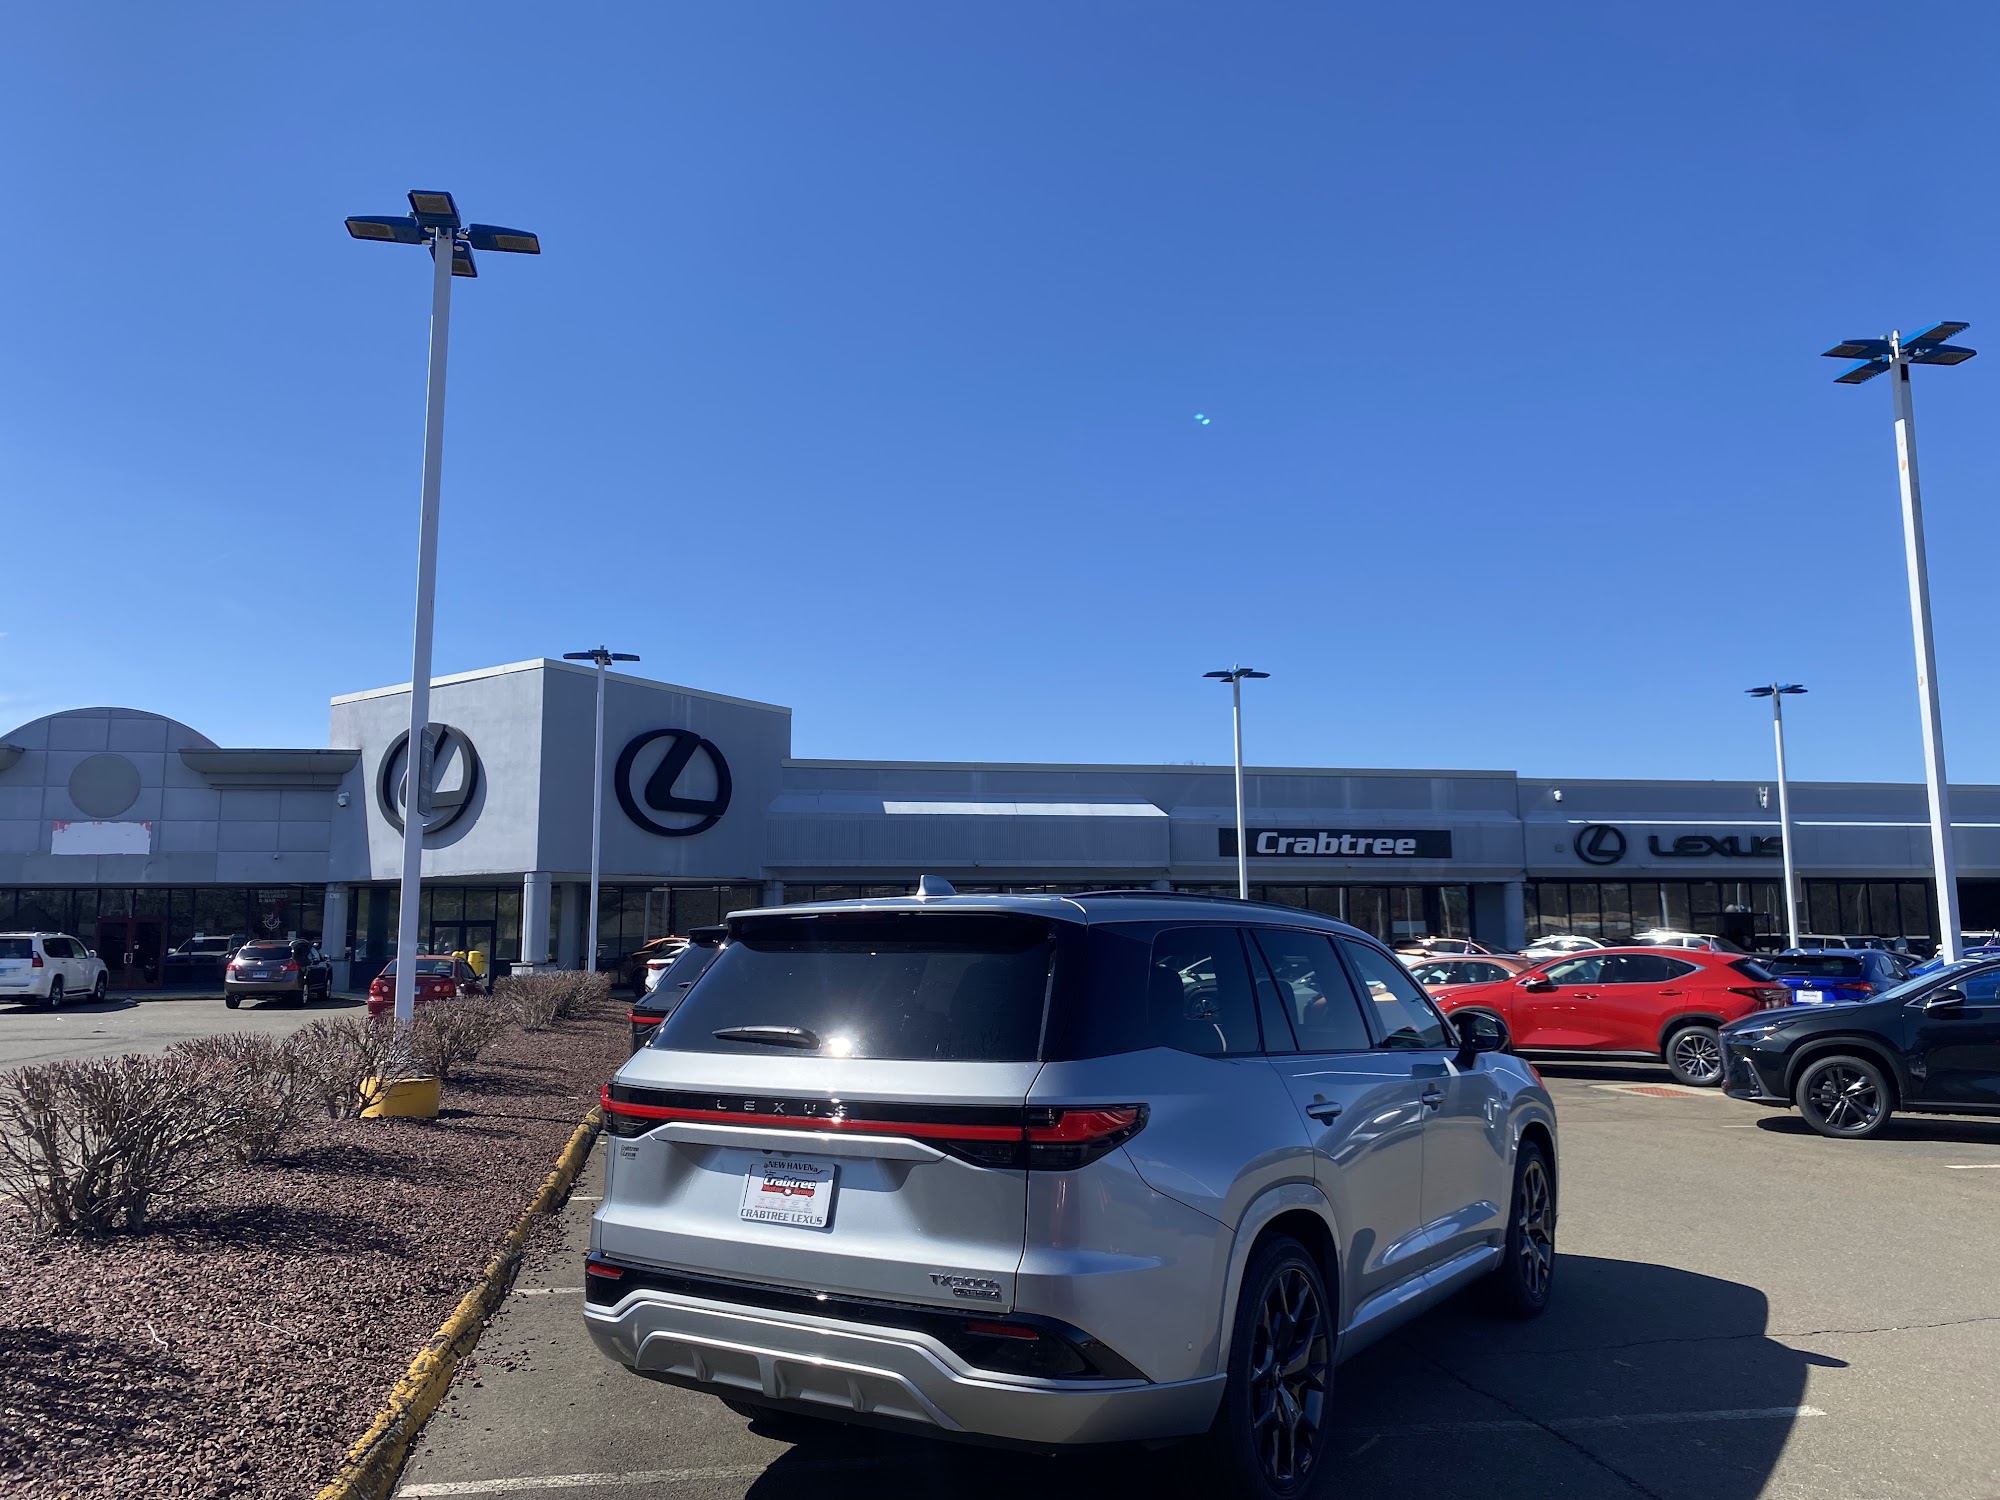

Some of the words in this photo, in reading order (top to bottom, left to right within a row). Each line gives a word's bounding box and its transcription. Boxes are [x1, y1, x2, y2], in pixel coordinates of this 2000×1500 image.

[1256, 831, 1417, 855] Crabtree
[1648, 835, 1784, 857] LEXUS
[716, 1099, 848, 1116] LEXUS
[768, 1161, 785, 1169] NEW
[787, 1163, 814, 1172] HAVEN
[763, 1174, 817, 1189] Crabtree
[740, 1208, 789, 1221] CRABTREE
[791, 1214, 823, 1225] LEXUS
